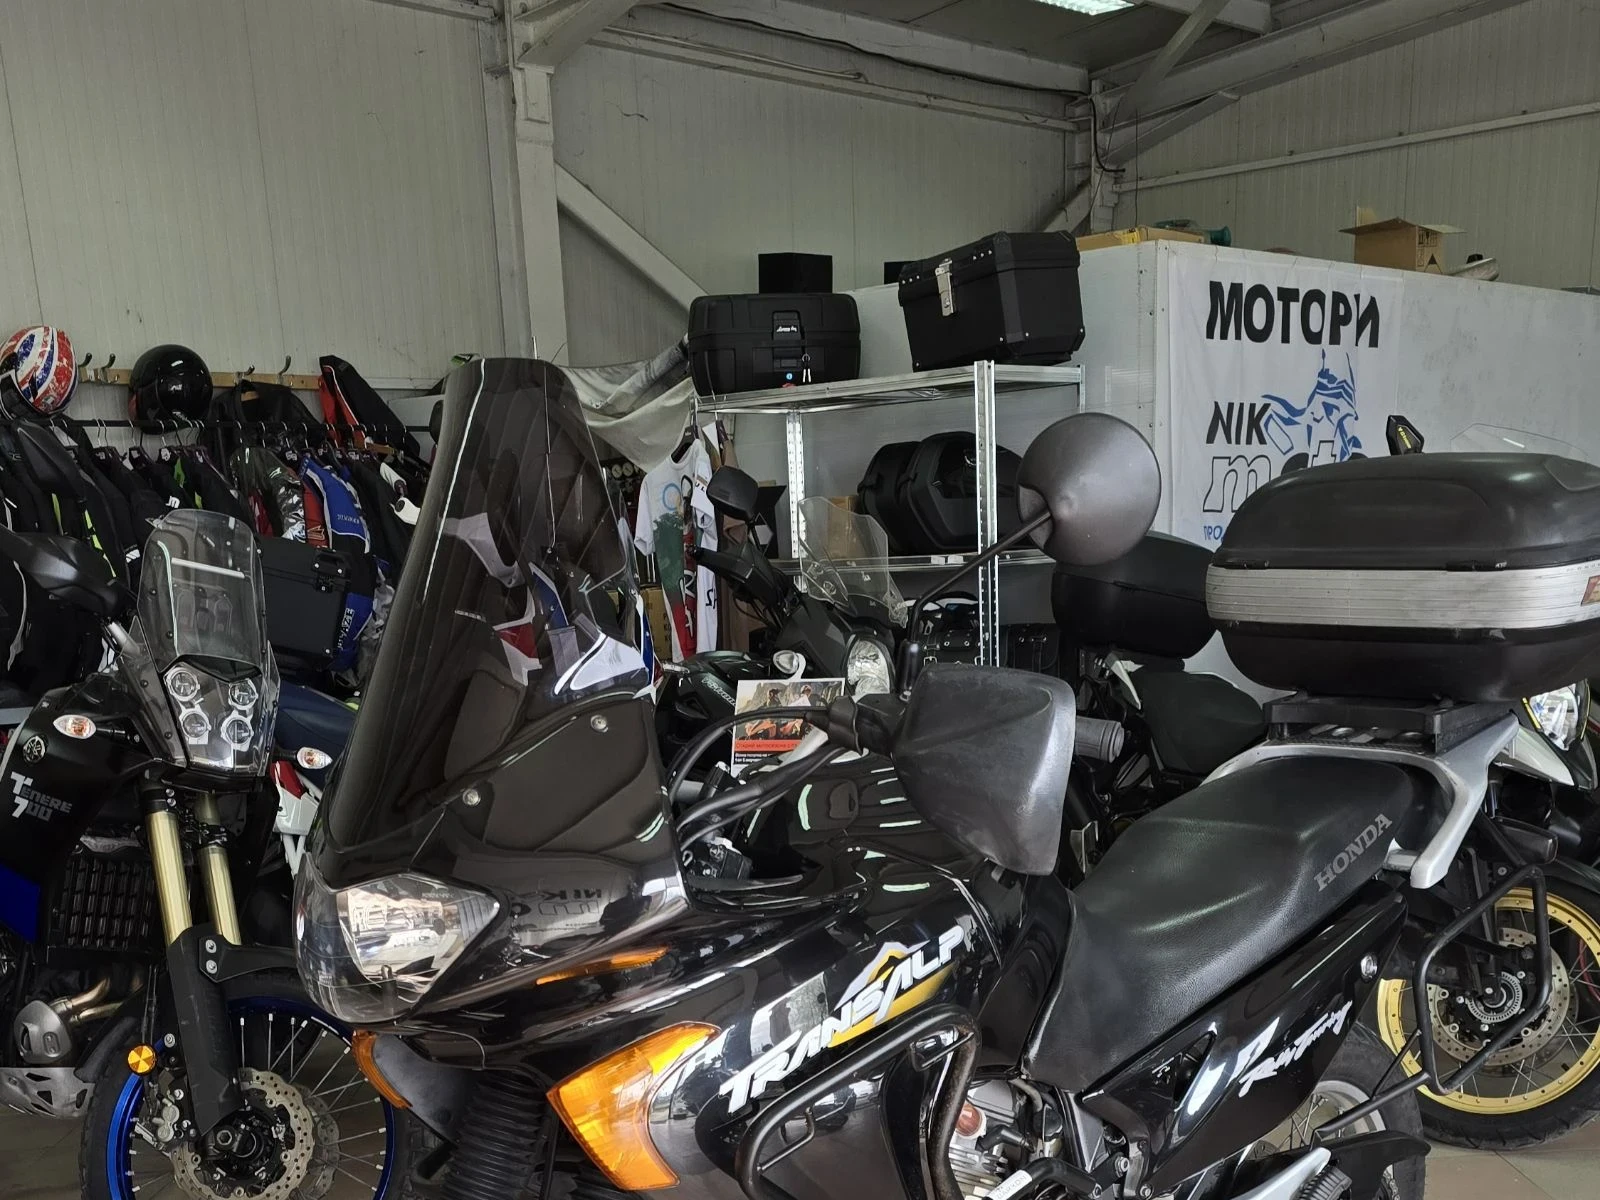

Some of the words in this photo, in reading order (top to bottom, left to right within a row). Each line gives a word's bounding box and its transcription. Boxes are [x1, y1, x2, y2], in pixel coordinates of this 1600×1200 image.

[1206, 281, 1380, 348] МОТОРИ
[1206, 401, 1271, 445] NIK
[12, 795, 53, 821] 700
[1313, 813, 1393, 892] HONDA
[718, 924, 965, 1114] TRANSALP
